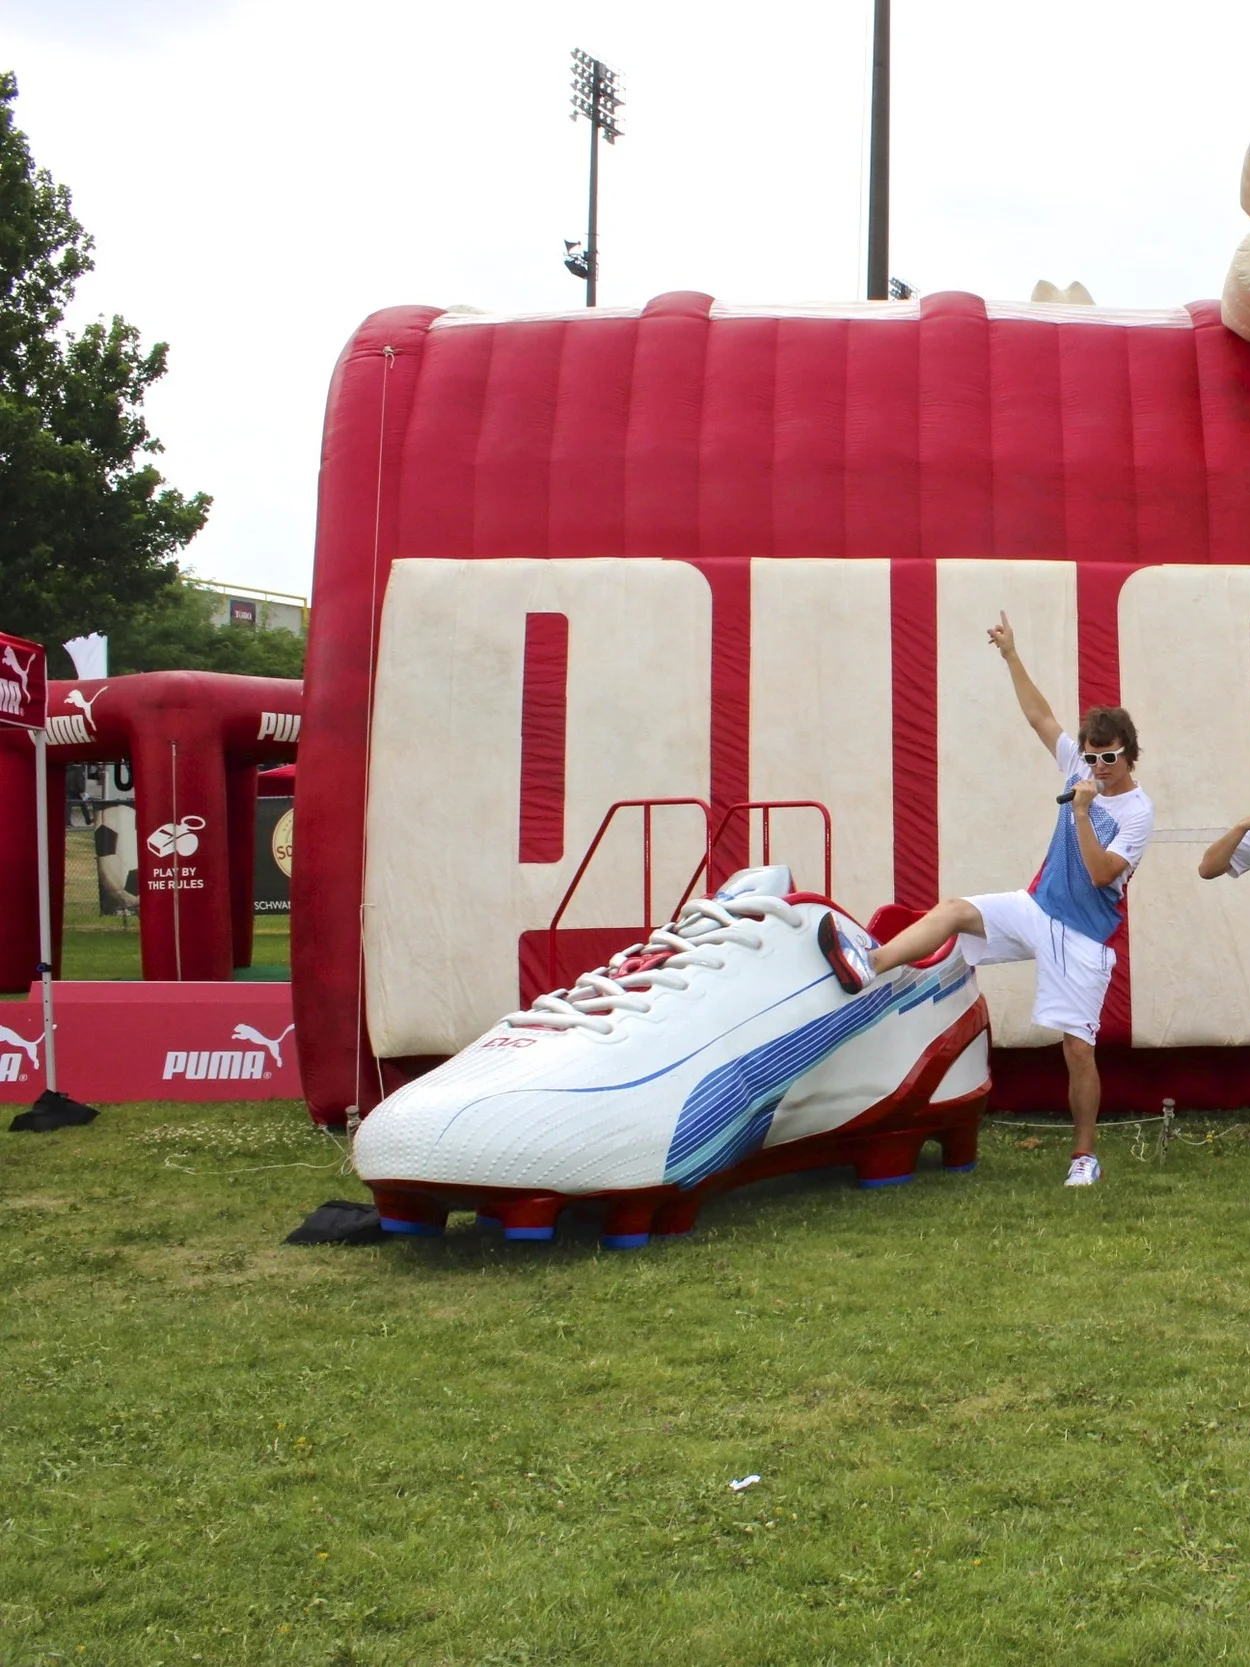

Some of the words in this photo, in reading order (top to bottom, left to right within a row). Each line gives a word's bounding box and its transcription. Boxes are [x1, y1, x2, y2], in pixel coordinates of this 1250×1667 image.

[153, 867, 178, 878] PLAY
[181, 867, 197, 877] BY
[148, 881, 166, 890] THE
[168, 879, 205, 890] RULES
[162, 1051, 266, 1080] PUMA
